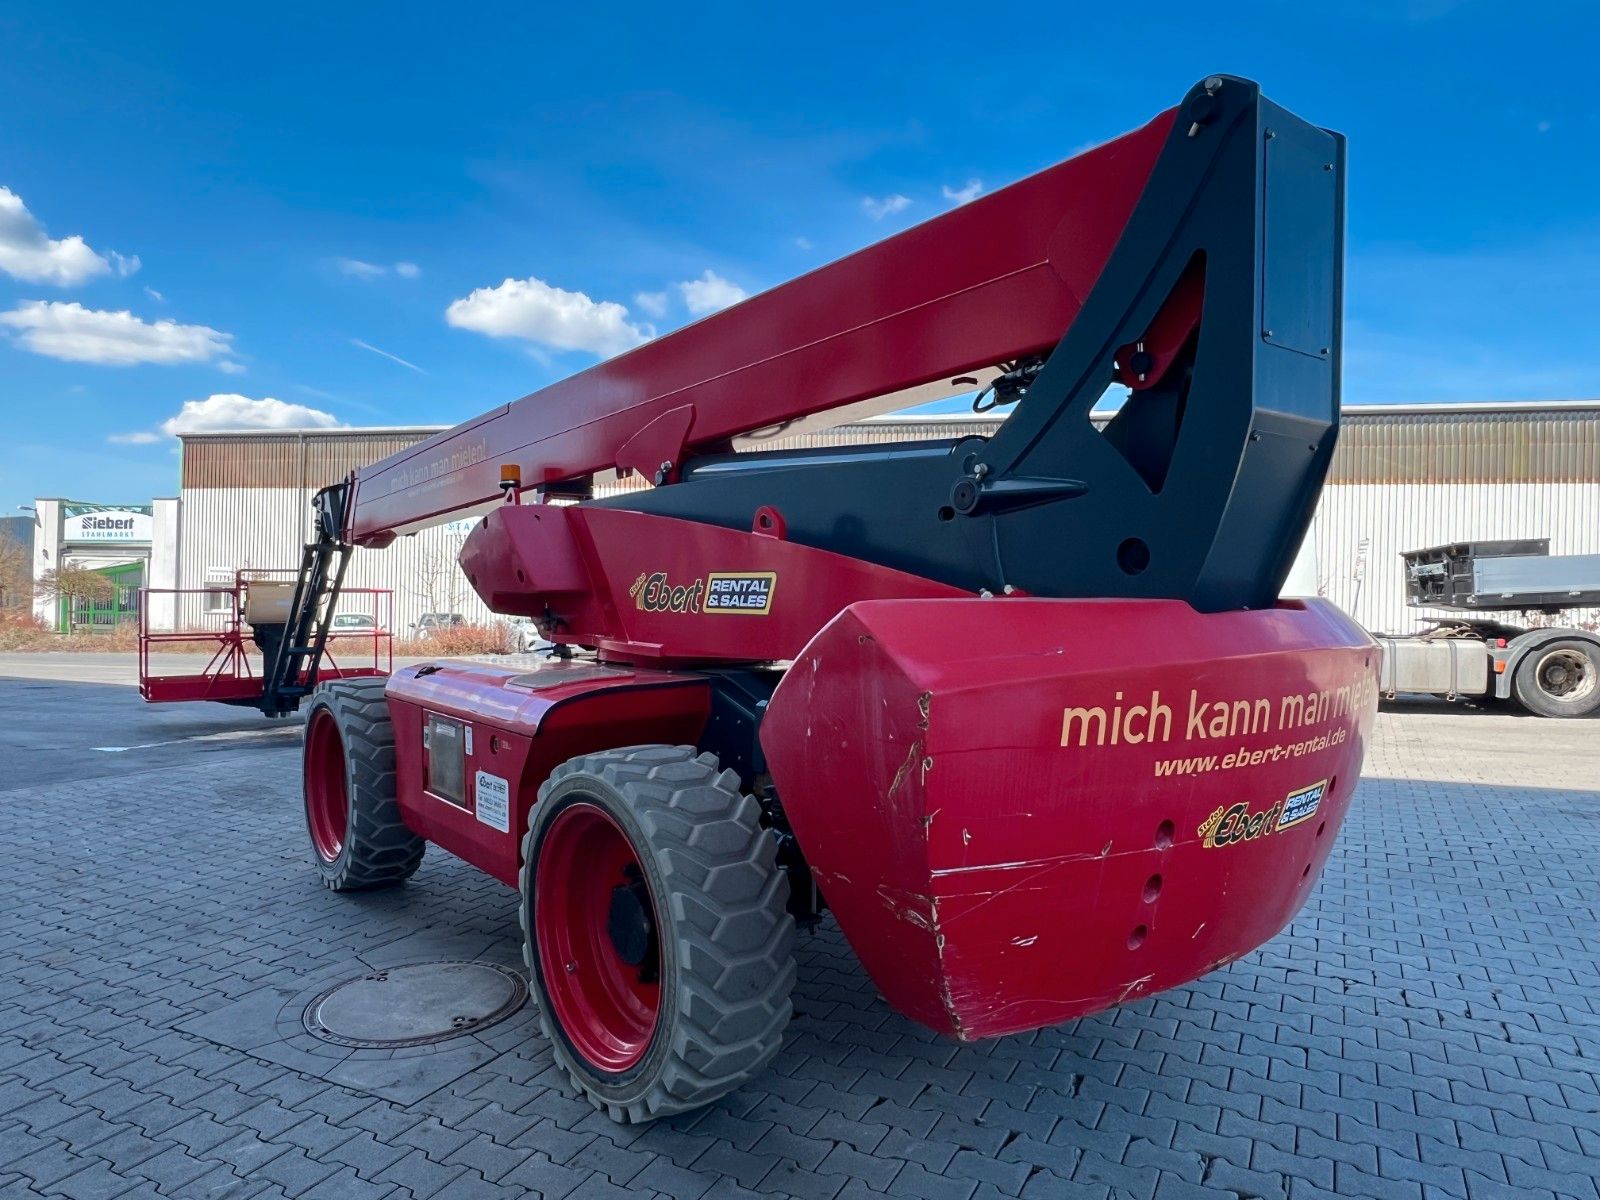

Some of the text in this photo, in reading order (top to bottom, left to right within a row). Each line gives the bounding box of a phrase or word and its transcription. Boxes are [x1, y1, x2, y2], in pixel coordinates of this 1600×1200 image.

[409, 465, 429, 485] kann
[431, 458, 449, 475] man
[82, 517, 134, 529] Siebert
[643, 572, 704, 614] Ebert
[711, 579, 769, 593] RENTAL
[708, 594, 767, 608] & SALES
[1060, 690, 1172, 747] mich
[1185, 689, 1271, 741] kann
[1278, 690, 1330, 731] man
[1155, 726, 1346, 777] www.ebert-rental.de
[1287, 788, 1322, 808] RENTAL
[1290, 801, 1318, 820] SALES
[1214, 801, 1281, 847] Ebert
